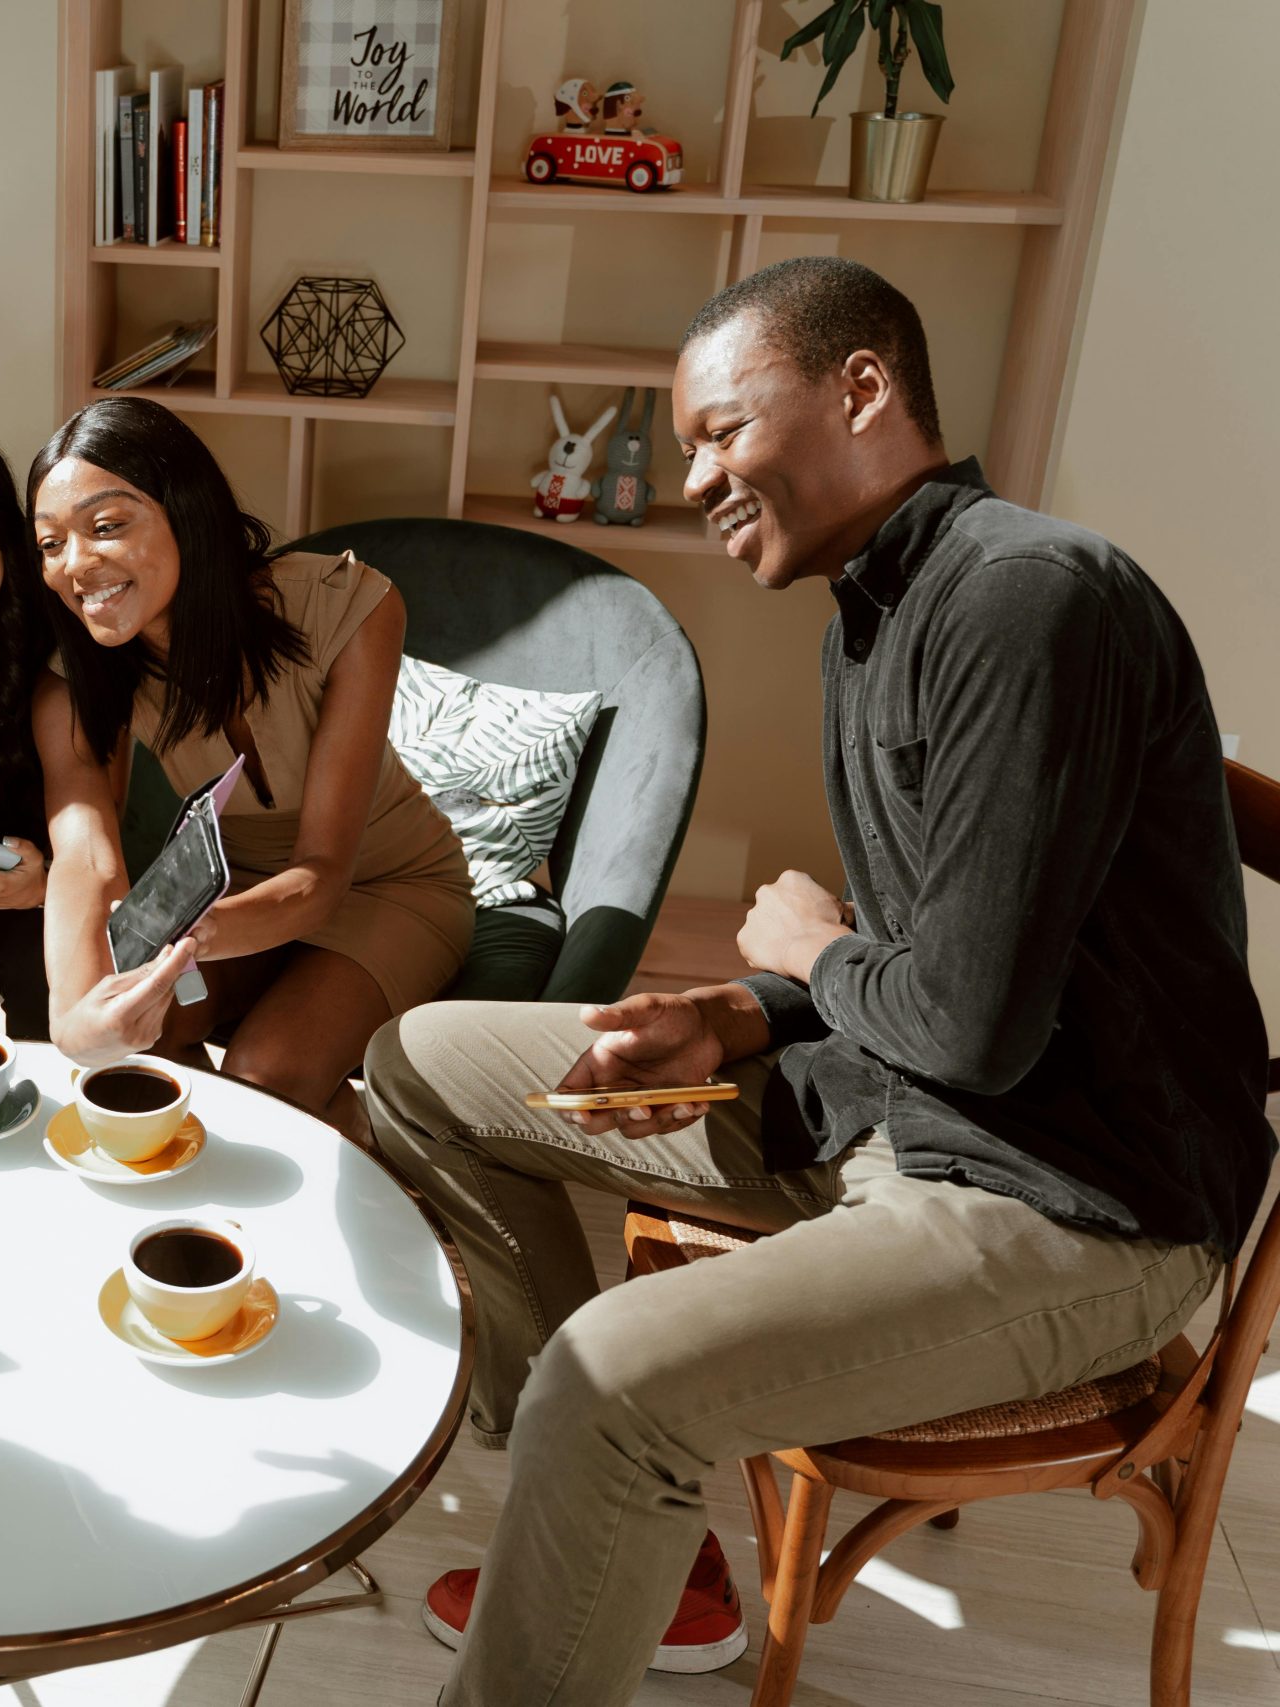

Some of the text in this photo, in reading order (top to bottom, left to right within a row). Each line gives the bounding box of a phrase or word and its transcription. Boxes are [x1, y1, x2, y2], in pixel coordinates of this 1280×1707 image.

[350, 25, 414, 95] Joy
[357, 70, 373, 79] TO
[353, 81, 376, 91] THE
[333, 79, 428, 125] World
[575, 144, 624, 164] LOVE
